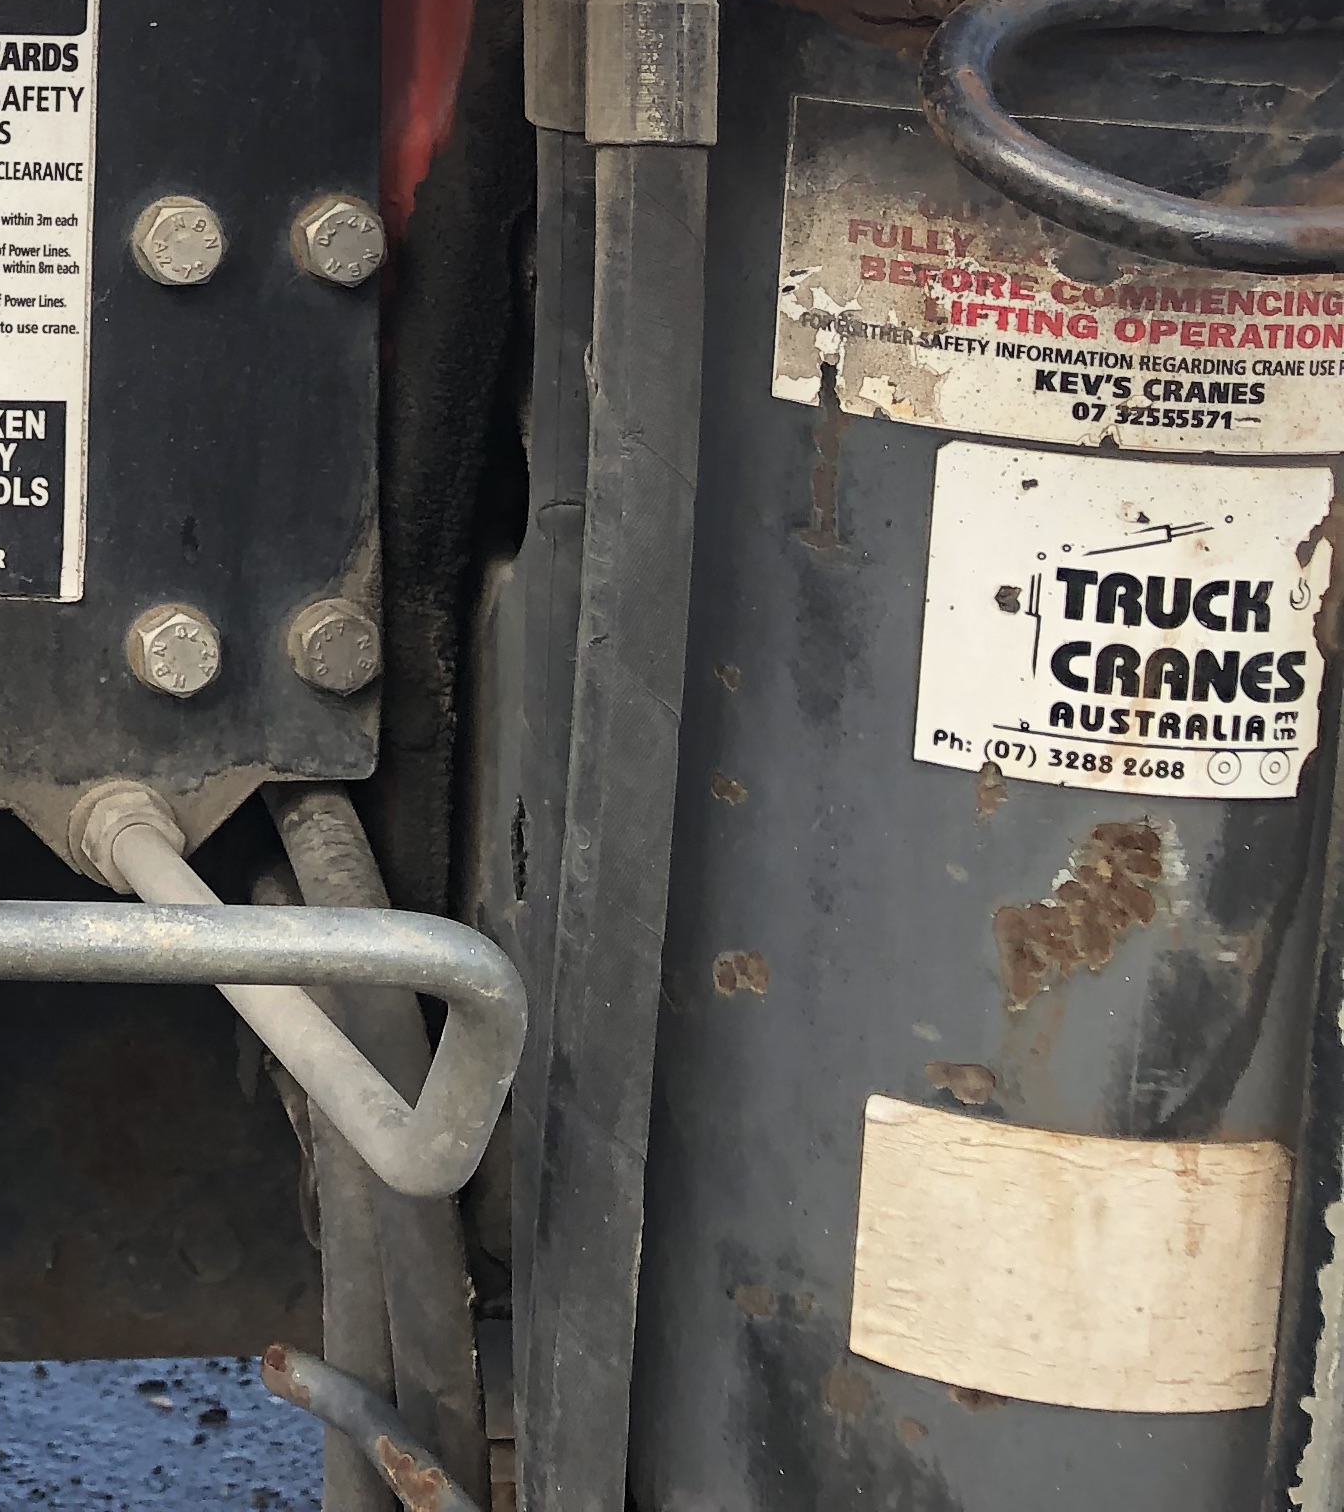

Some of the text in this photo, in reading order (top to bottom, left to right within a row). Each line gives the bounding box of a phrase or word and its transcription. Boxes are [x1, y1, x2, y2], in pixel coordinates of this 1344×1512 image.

[0, 211, 34, 226] within
[36, 212, 52, 226] 3m
[54, 212, 78, 227] each
[847, 218, 977, 258] FULLY
[2, 259, 36, 274] within
[37, 260, 54, 274] 8m
[55, 261, 80, 275] each
[7, 243, 41, 257] Power
[42, 243, 71, 257] Lines.
[859, 254, 1343, 318] BEFORE COMMENCING
[16, 323, 39, 334] use
[41, 323, 79, 335] crane.
[924, 296, 1099, 340] LIFTING
[918, 331, 1336, 376] SAFETY INFORMATION REGARDING CRANE USE
[1035, 369, 1266, 405] KEV'S CRANES
[1071, 401, 1234, 430] 07 32555571
[1055, 566, 1274, 633] TRUCK
[1050, 640, 1307, 704] CRANES
[1049, 701, 1266, 743] AUSTRALIA
[1273, 711, 1299, 726] PTY
[1273, 726, 1298, 741] LTD
[932, 728, 1186, 780] Ph: (07) 3288 2688
